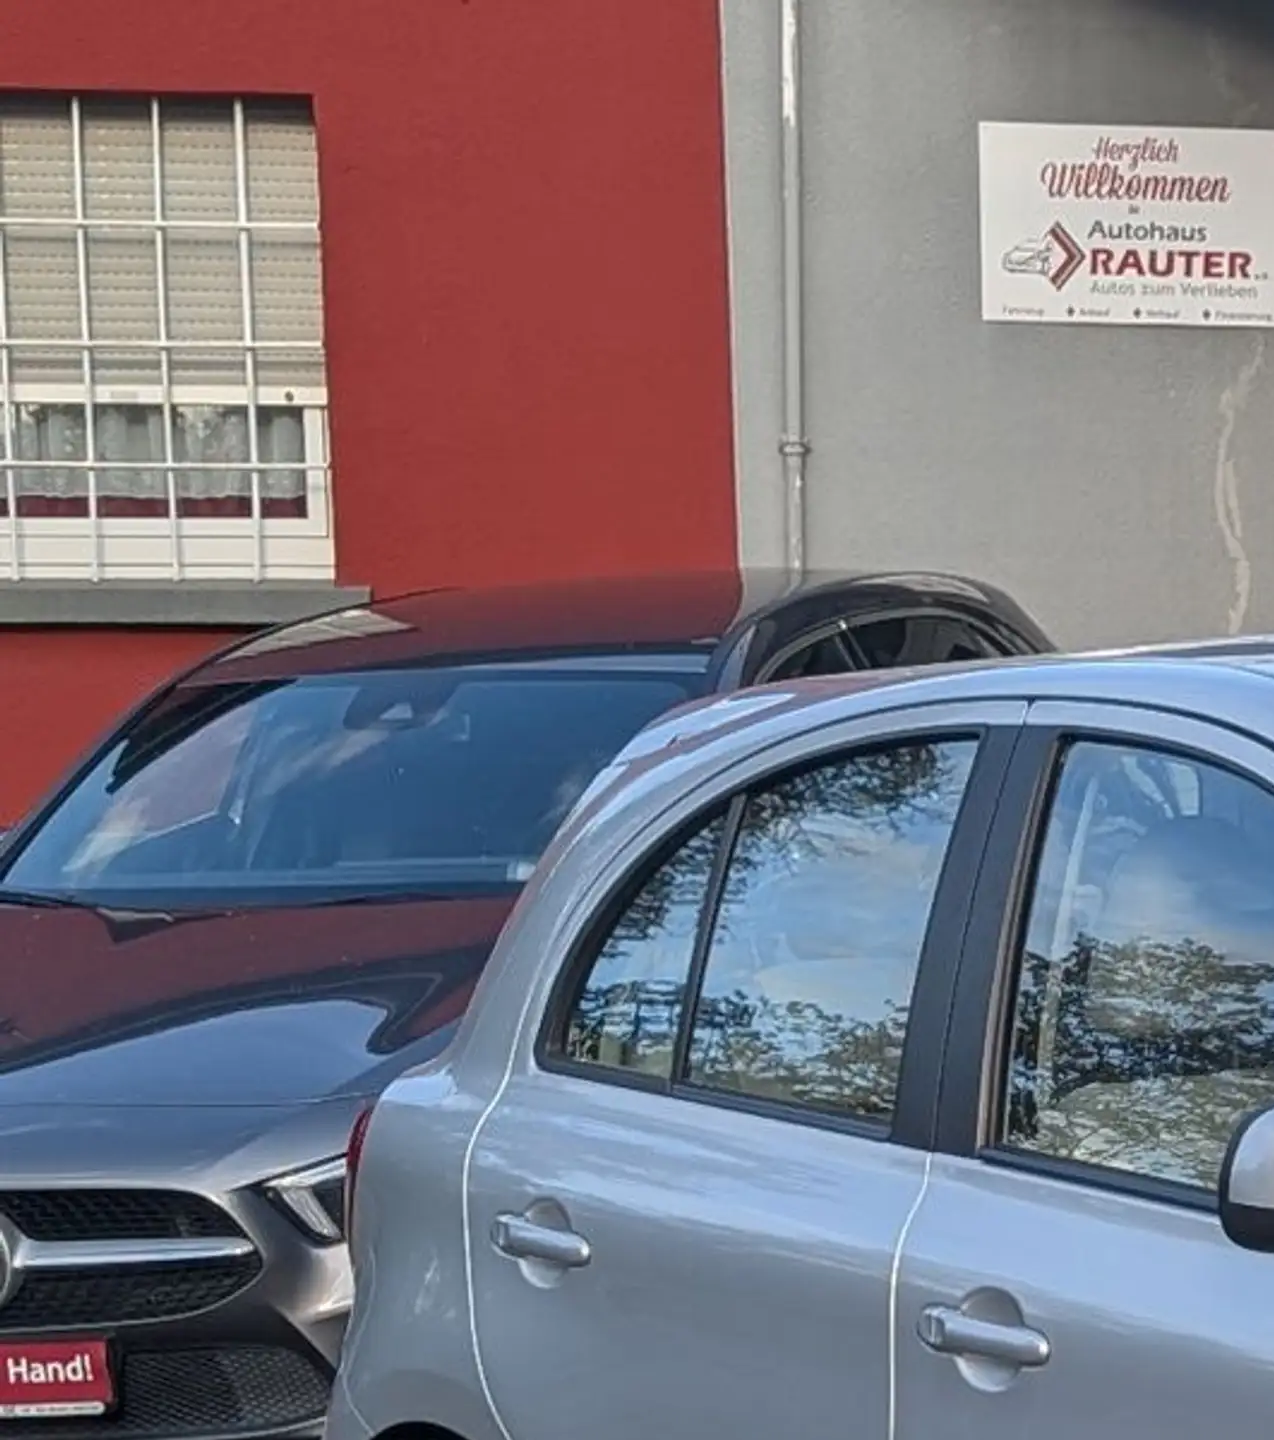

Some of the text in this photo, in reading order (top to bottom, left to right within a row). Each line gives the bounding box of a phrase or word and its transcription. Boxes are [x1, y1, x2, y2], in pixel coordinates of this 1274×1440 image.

[1093, 136, 1179, 171] Herzlich
[1041, 162, 1231, 203] Willkommen
[1087, 220, 1207, 242] Autohaus
[1090, 248, 1252, 279] RAUTER
[1090, 282, 1259, 299] Autos zum Verlieben
[7, 1353, 95, 1385] Hand!
